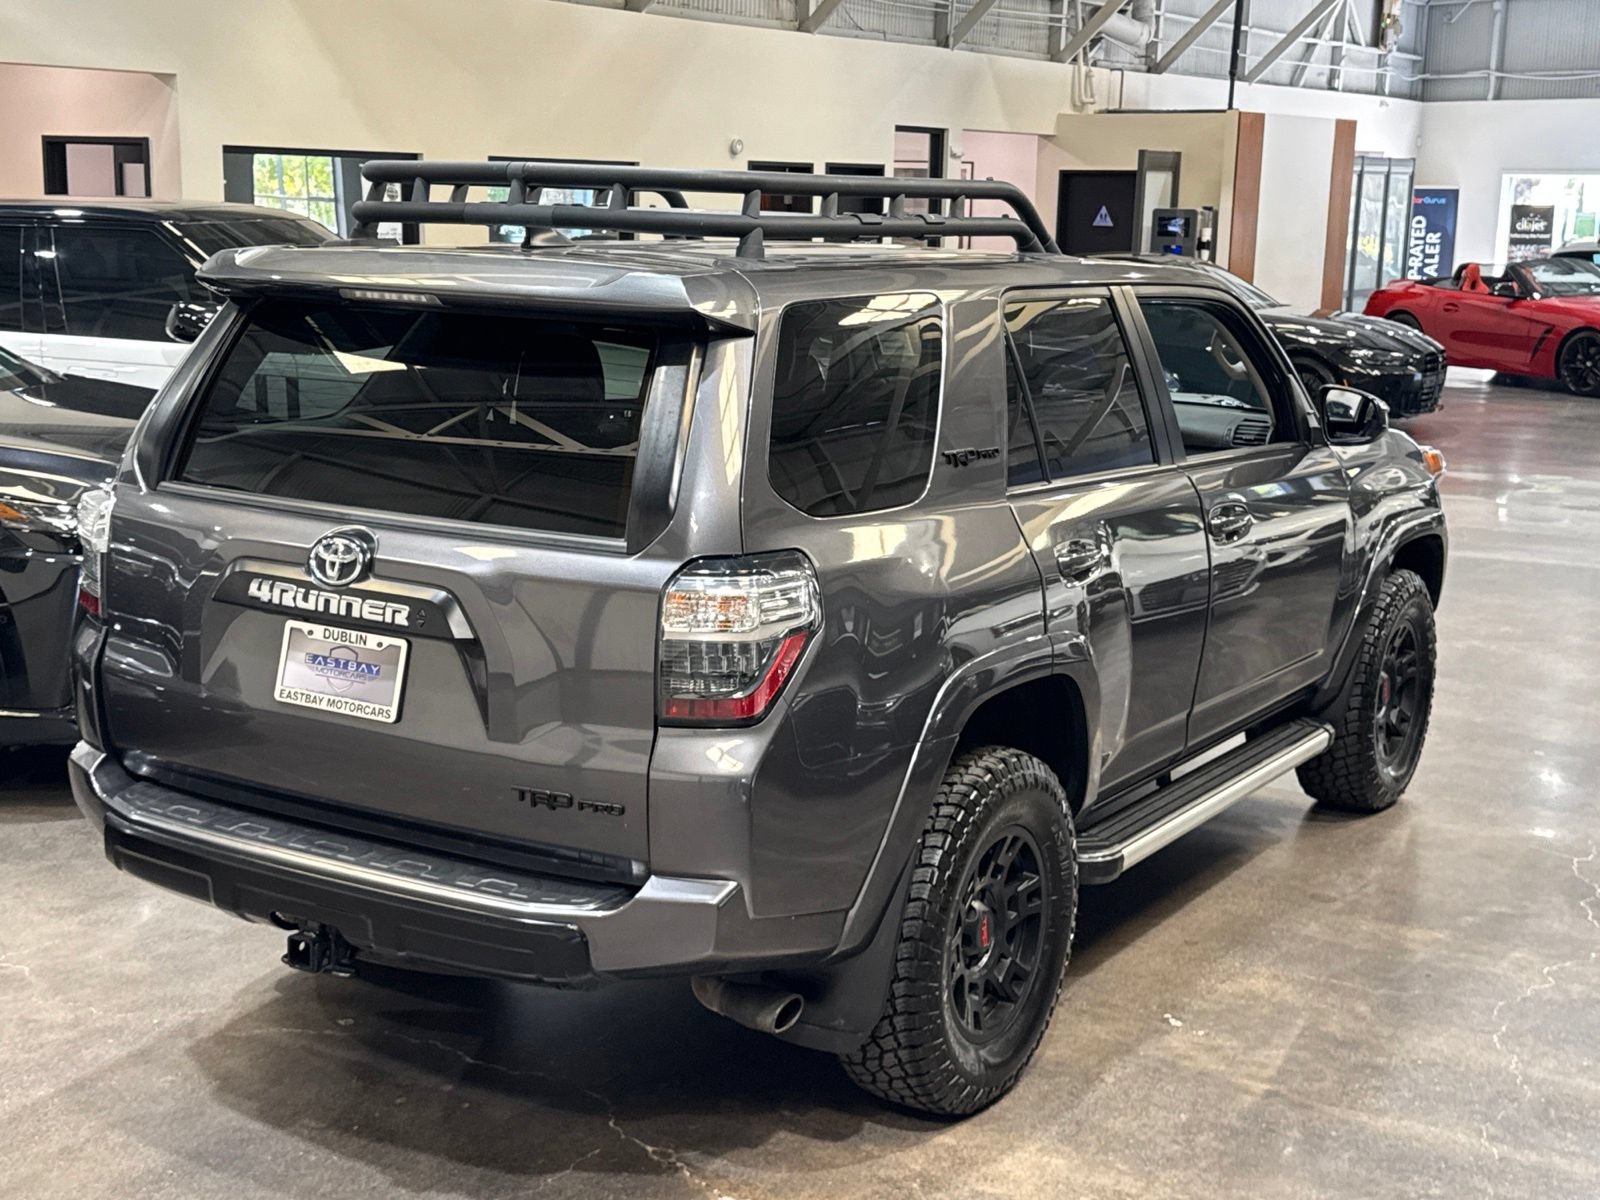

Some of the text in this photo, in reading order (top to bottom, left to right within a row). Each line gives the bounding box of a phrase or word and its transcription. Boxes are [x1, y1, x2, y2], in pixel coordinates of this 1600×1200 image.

[1412, 196, 1446, 205] arGurus
[1422, 232, 1442, 280] ALER
[323, 628, 368, 646] DUBLIN
[305, 653, 380, 676] EASTBAY
[315, 665, 368, 681] MOTORCARS
[279, 688, 392, 719] EASTBAY MOTORCARS
[511, 785, 625, 816] TRD PRO
